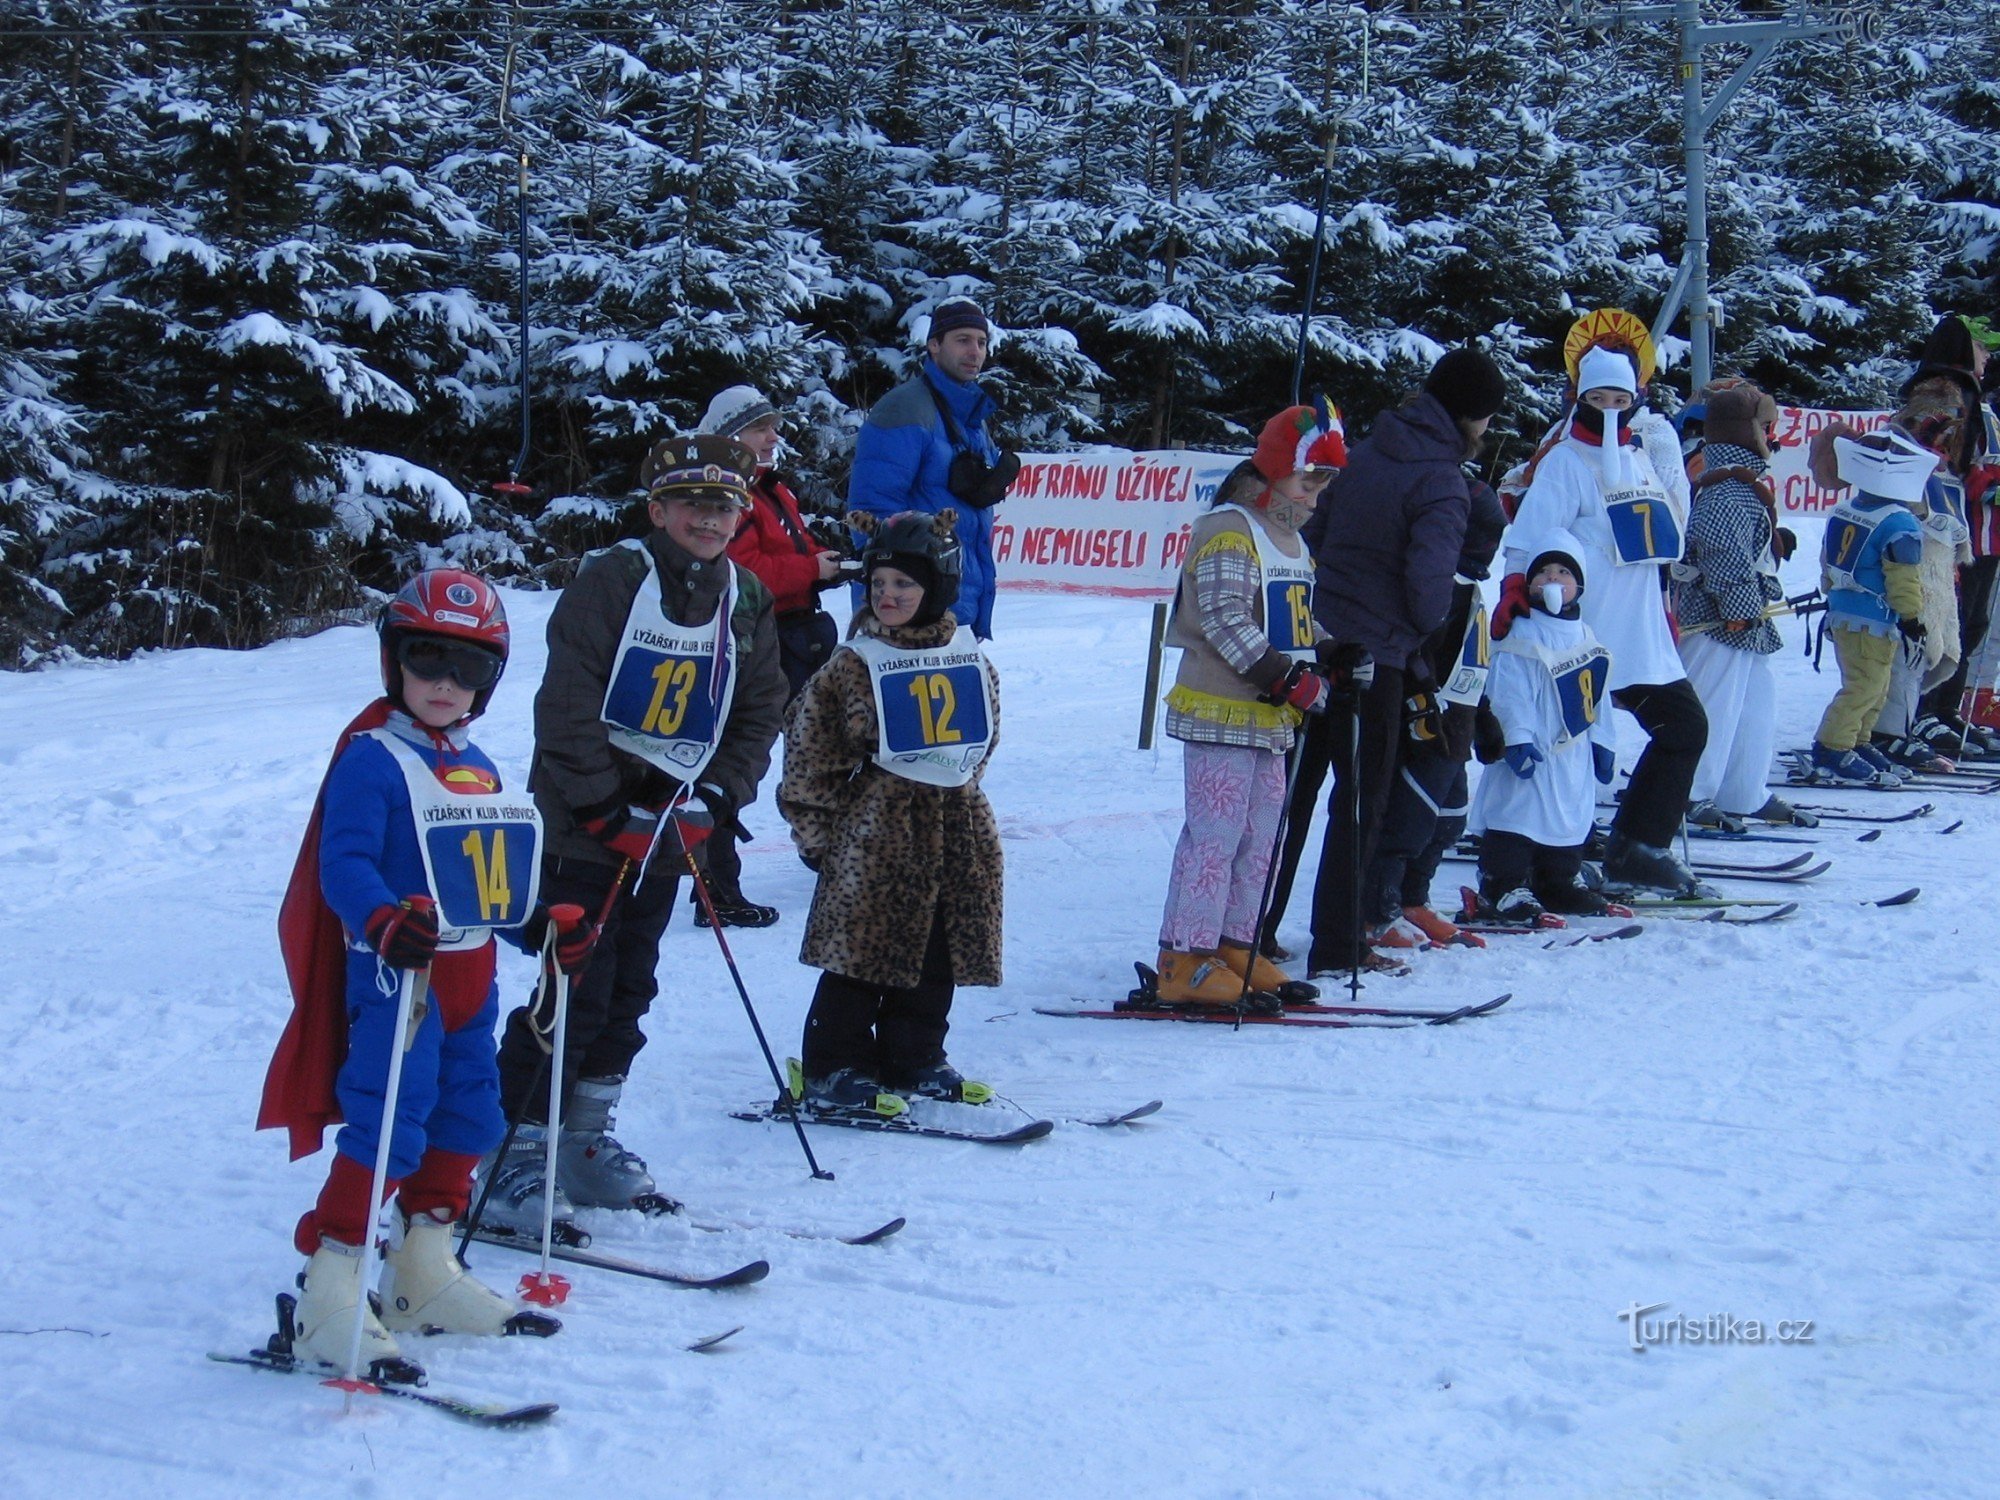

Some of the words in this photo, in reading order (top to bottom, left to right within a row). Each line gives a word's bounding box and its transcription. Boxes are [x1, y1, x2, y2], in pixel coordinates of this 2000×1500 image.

[1020, 527, 1147, 569] NEMUSELI
[1632, 503, 1655, 557] 7
[1835, 524, 1855, 566] 9
[632, 628, 680, 652] LYŽAŘSKÝ
[681, 639, 699, 652] KLUB
[1286, 584, 1314, 648] 15
[877, 656, 921, 673] LYŽAŘSKÝ
[923, 656, 941, 668] KLUB
[640, 659, 696, 736] 13
[908, 672, 961, 745] 12
[1578, 669, 1595, 723] 8
[423, 803, 472, 823] LYŽAŘSKÝ
[476, 806, 499, 821] KLUB
[462, 829, 511, 921] 14
